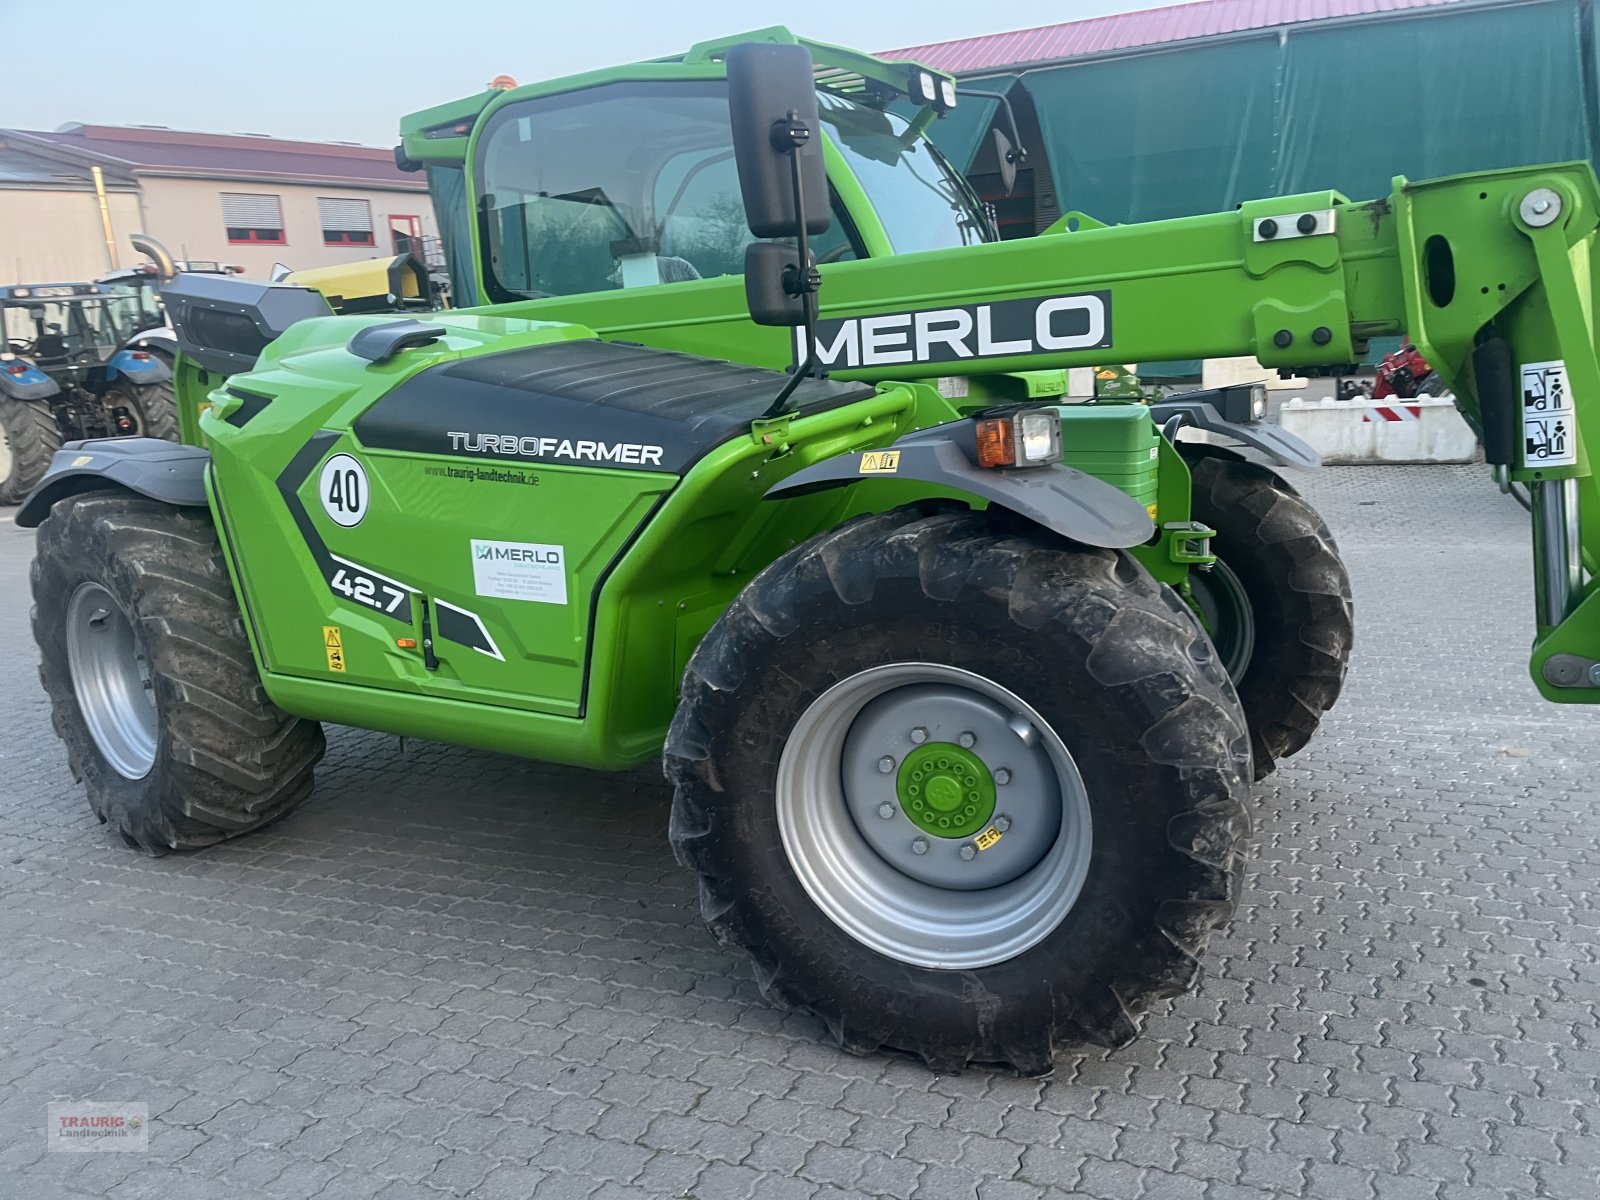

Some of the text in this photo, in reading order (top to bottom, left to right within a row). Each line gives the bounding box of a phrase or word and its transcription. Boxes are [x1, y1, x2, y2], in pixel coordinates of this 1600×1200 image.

[796, 294, 1106, 369] MERLO
[446, 431, 664, 466] TURBOFARMER
[329, 468, 360, 514] 40
[424, 466, 540, 487] www.traurig-landtechnik.de
[495, 547, 560, 564] MERLO
[331, 568, 405, 614] 42.7
